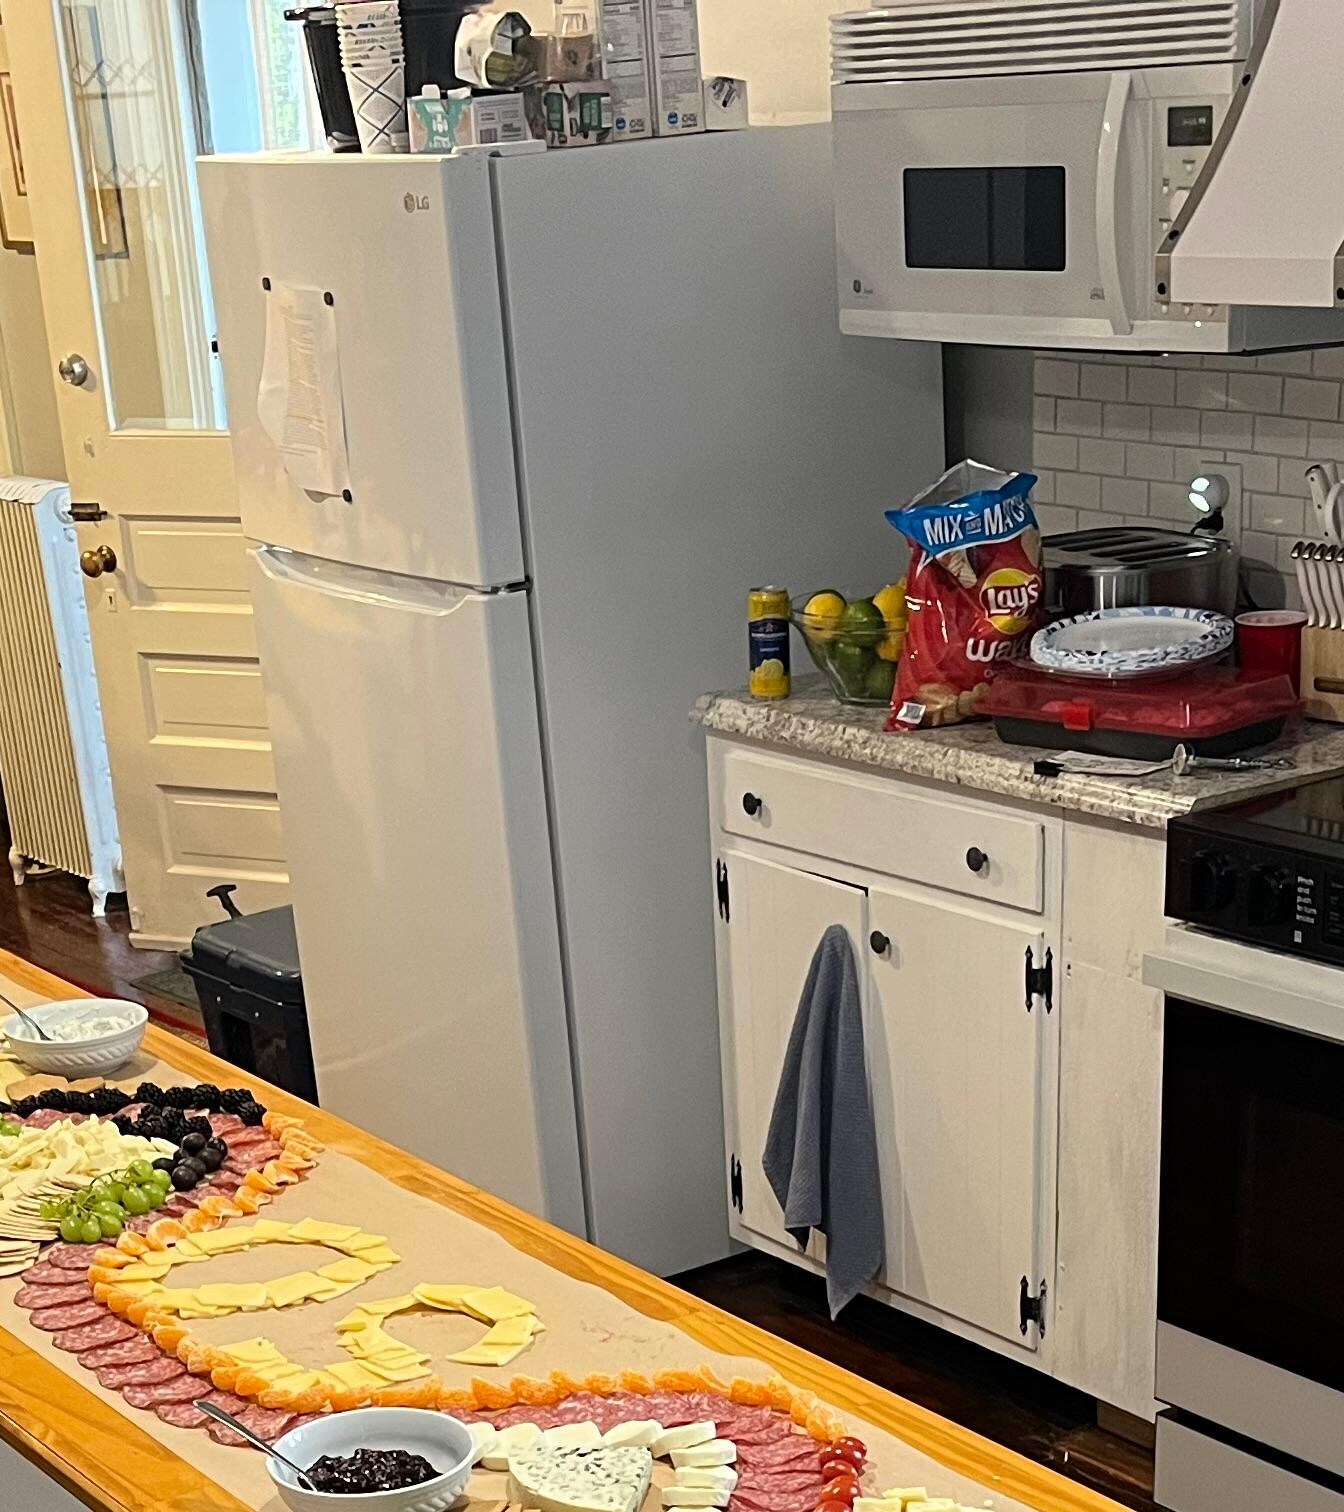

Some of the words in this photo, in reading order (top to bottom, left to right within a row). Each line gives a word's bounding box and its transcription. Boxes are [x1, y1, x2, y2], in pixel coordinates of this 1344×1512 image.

[415, 195, 430, 210] LG
[923, 514, 964, 546] MIX
[984, 495, 1026, 536] MAC
